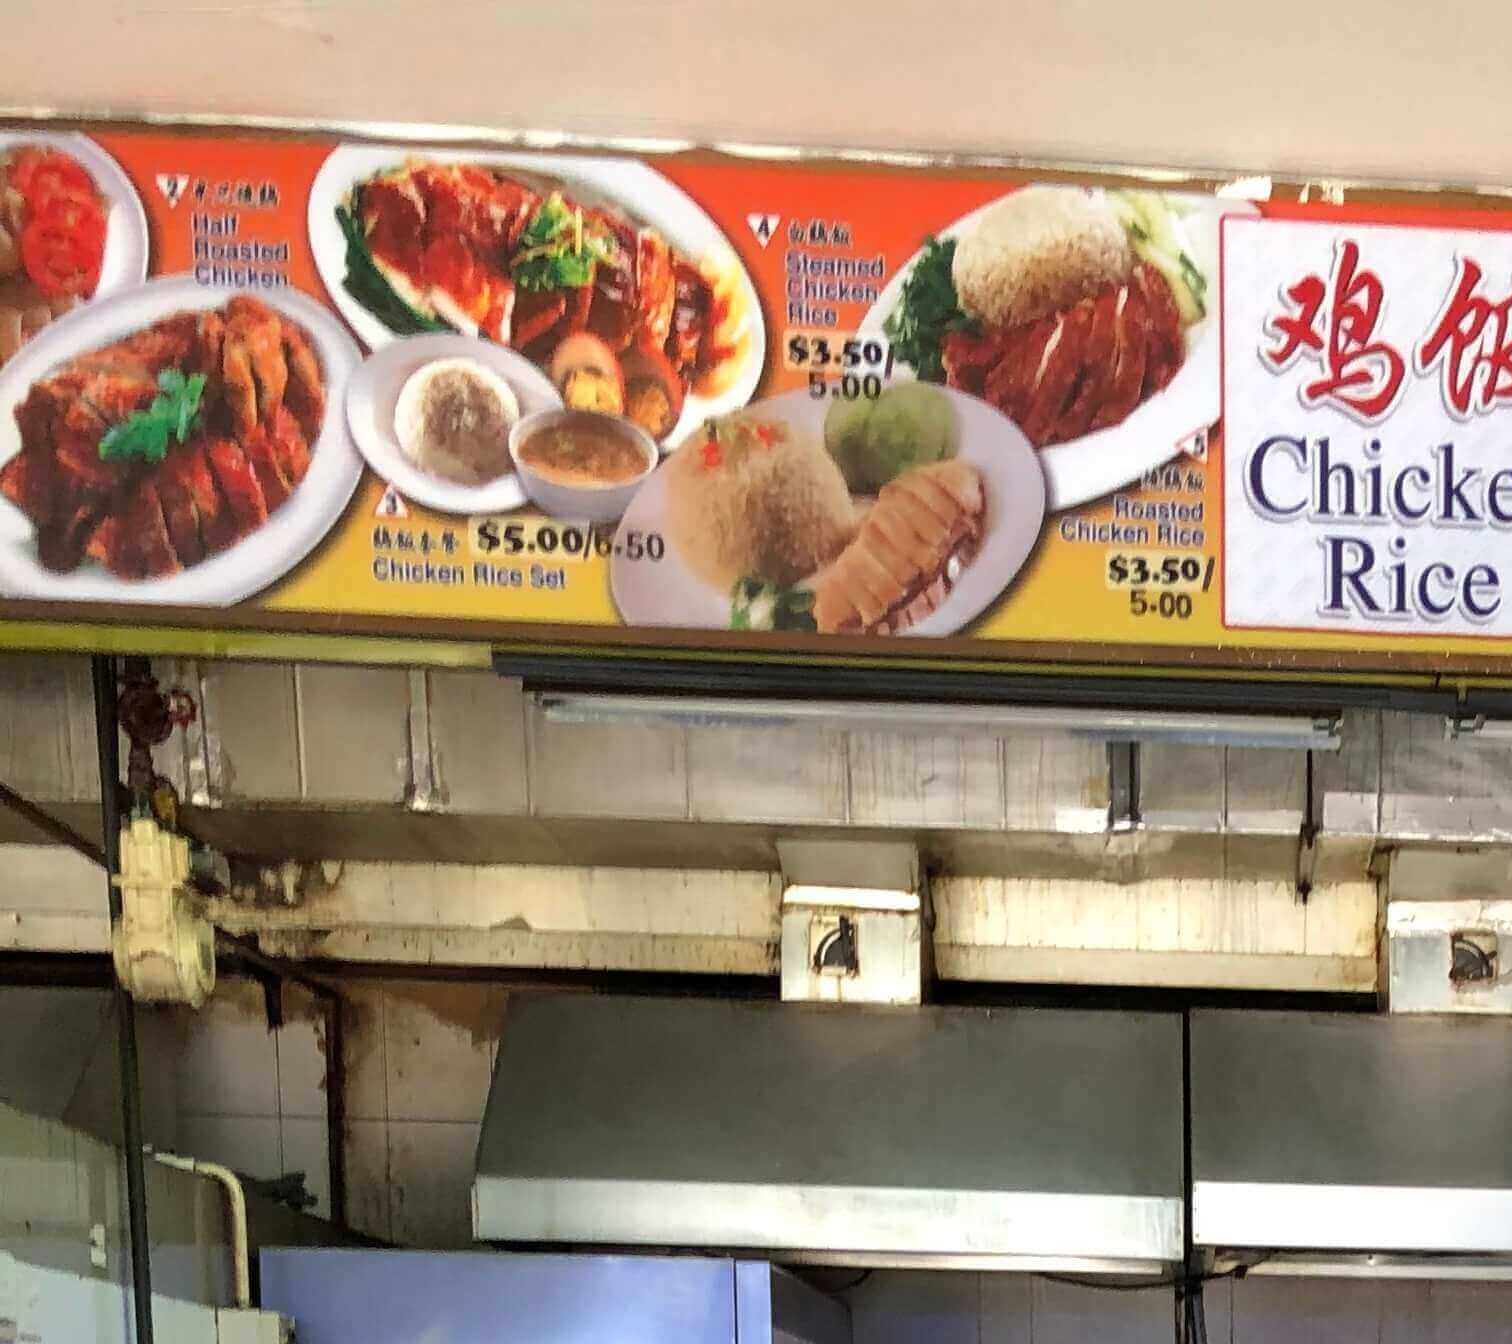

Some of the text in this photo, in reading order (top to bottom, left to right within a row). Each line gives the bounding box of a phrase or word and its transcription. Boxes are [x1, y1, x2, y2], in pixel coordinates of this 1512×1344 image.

[1060, 517, 1149, 545] Chicken
[372, 558, 465, 587] Chicken
[1322, 536, 1503, 618] Rice
[1130, 590, 1192, 619] 5.00
